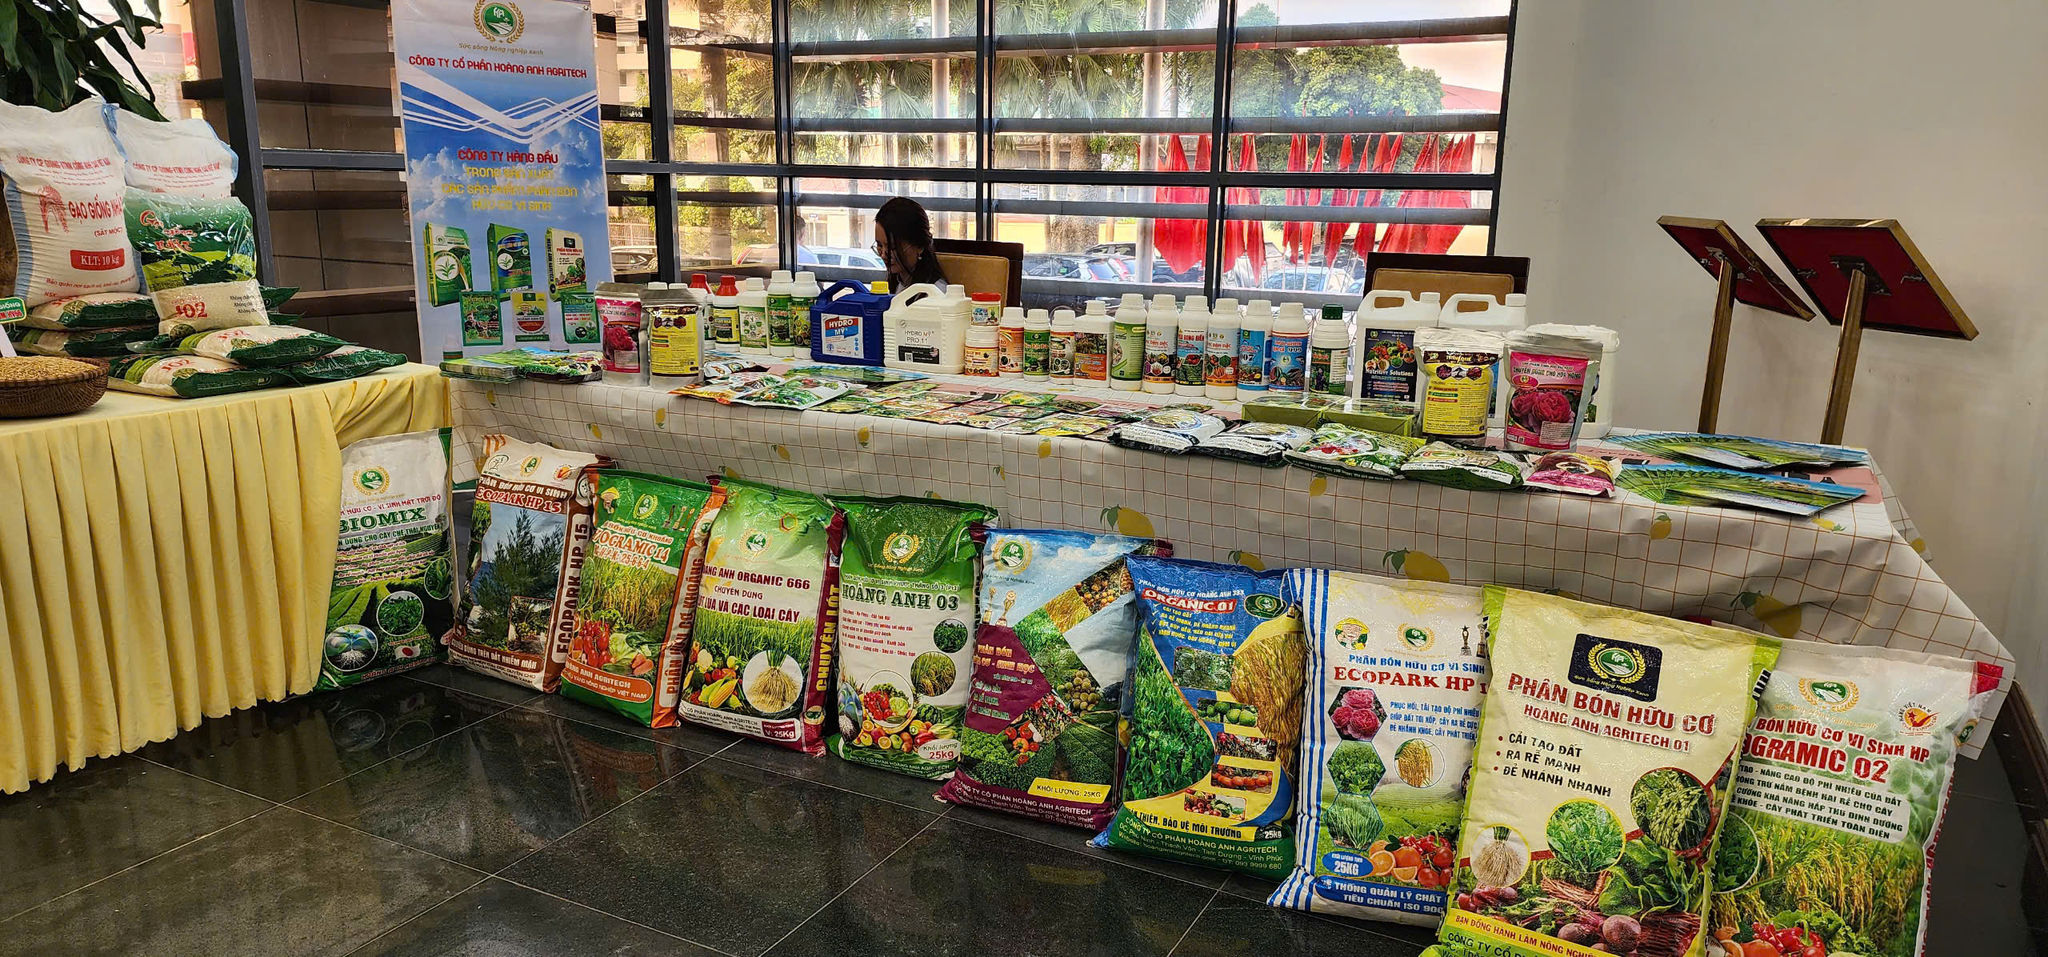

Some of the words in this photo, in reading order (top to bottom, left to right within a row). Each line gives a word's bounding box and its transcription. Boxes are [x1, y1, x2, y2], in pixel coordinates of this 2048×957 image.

[409, 54, 435, 66] CÔNG
[438, 58, 450, 68] TY
[494, 62, 524, 74] HOÀNG
[526, 66, 544, 74] ANH
[546, 68, 587, 78] AGRITECH
[458, 148, 488, 160] CÔNG
[490, 150, 503, 162] TY
[506, 150, 534, 163] HÀNG
[68, 200, 88, 224] GẠO
[88, 194, 112, 220] GIỐNG
[102, 255, 110, 264] 10
[828, 318, 854, 328] HYDRO
[476, 486, 524, 506] ECOPARK
[526, 496, 543, 509] HP
[544, 500, 562, 512] 15
[546, 488, 568, 498] SINH
[340, 508, 426, 533] BIOMIX
[575, 523, 588, 540] 15
[570, 545, 585, 570] HP
[654, 548, 670, 562] 14
[719, 568, 736, 580] ANH
[738, 571, 784, 587] ORGANIC
[786, 578, 811, 590] 666
[826, 584, 840, 612] LÓT
[842, 584, 888, 605] HOÀNG
[892, 592, 932, 610] ANH
[936, 595, 959, 610] 03
[557, 572, 581, 653] ECOPARK
[718, 598, 729, 612] VÀ
[778, 608, 800, 623] CÂY
[816, 622, 837, 692] CHUYÊN
[1348, 654, 1376, 666] PHÂN
[1380, 656, 1402, 667] BÓN
[1405, 660, 1428, 671] HỮU
[1431, 663, 1445, 672] CƠ
[1448, 662, 1459, 671] VI
[1462, 662, 1485, 675] SINH
[594, 674, 631, 688] AGRITECH
[665, 660, 683, 695] PHÂN
[1334, 666, 1440, 688] ECOPARK
[1445, 676, 1475, 692] HP
[1480, 682, 1488, 694] 1
[1508, 672, 1568, 706] PHÂN
[1573, 689, 1622, 718] BÓN
[1627, 703, 1675, 730] HỮU
[1682, 714, 1716, 735] CƠ
[774, 730, 794, 738] 25Kg
[1524, 704, 1569, 726] HOÀNG
[1571, 716, 1600, 734] ANH
[1604, 724, 1670, 748] AGRITECH
[1673, 739, 1690, 752] 01
[1756, 716, 1786, 734] BÓN
[1787, 719, 1818, 737] HỮU
[1821, 726, 1846, 743] CƠ
[1848, 732, 1864, 750] VI
[1866, 738, 1905, 757] SINH
[1910, 744, 1930, 764] HP
[930, 750, 954, 760] 25kg
[1508, 731, 1526, 746] CẢI
[1532, 736, 1556, 753] TẠO
[1558, 742, 1583, 758] ĐẤT
[1506, 750, 1520, 760] RA
[1525, 748, 1540, 764] RỄ
[1544, 757, 1581, 774] MẠNH
[1854, 757, 1889, 784] 02
[1503, 763, 1518, 777] ĐẺ
[1522, 768, 1564, 786] NHÁNH
[1568, 779, 1612, 797] NHANH
[1760, 768, 1782, 780] NÂNG
[1784, 774, 1800, 782] CAO
[1803, 776, 1815, 786] ĐỘ
[1818, 780, 1832, 790] PHÌ
[1864, 790, 1883, 802] CỦA
[1885, 796, 1902, 808] ĐẤT
[1012, 796, 1038, 807] HOÀNG
[1039, 800, 1054, 810] ANH
[1055, 804, 1092, 816] AGRITECH
[1756, 779, 1773, 789] TRỪ
[1774, 782, 1793, 792] NẤM
[1796, 786, 1819, 798] BỆNH
[1822, 792, 1837, 802] HẠI
[1839, 796, 1850, 807] RỄ
[1853, 800, 1872, 810] CHO
[1874, 805, 1894, 816] CÂY
[1764, 790, 1780, 802] KHẢ
[1782, 796, 1806, 808] NĂNG
[1808, 799, 1826, 812] HẤP
[1828, 806, 1846, 817] THU
[1848, 812, 1870, 823] DINH
[1873, 818, 1904, 832] DƯỠNG
[1766, 802, 1782, 812] CÂY
[1785, 808, 1808, 818] PHÁT
[1811, 813, 1838, 826] TRIỂN
[1841, 820, 1866, 832] TOÀN
[1868, 828, 1890, 840] DIỆN
[1126, 816, 1142, 832] CÔNG
[1142, 827, 1151, 836] TY
[1188, 837, 1216, 849] HOÀNG
[1218, 843, 1236, 852] ANH
[1236, 844, 1278, 854] AGRITECH
[1162, 816, 1178, 828] BẢO
[1180, 822, 1190, 832] VỆ
[1192, 822, 1208, 834] MÔI
[1210, 824, 1242, 838] TRƯỜNG
[1334, 861, 1359, 876] 25KG
[1335, 880, 1367, 894] THỐNG
[1370, 886, 1398, 898] QUẢN
[1400, 890, 1412, 900] LÝ
[1415, 891, 1442, 903] CHẤT
[1344, 893, 1364, 904] TIÊU
[1367, 896, 1400, 908] CHUẨN
[1404, 902, 1420, 911] ISO
[1448, 932, 1474, 948] CÔNG
[1478, 942, 1492, 950] TY
[1494, 945, 1512, 957] CỔ
[1456, 915, 1468, 926] BẠN
[1470, 919, 1491, 932] ĐỒNG
[1494, 926, 1516, 940] HÀNH
[1518, 934, 1536, 947] LÀM
[1540, 940, 1564, 954] NÔNG
